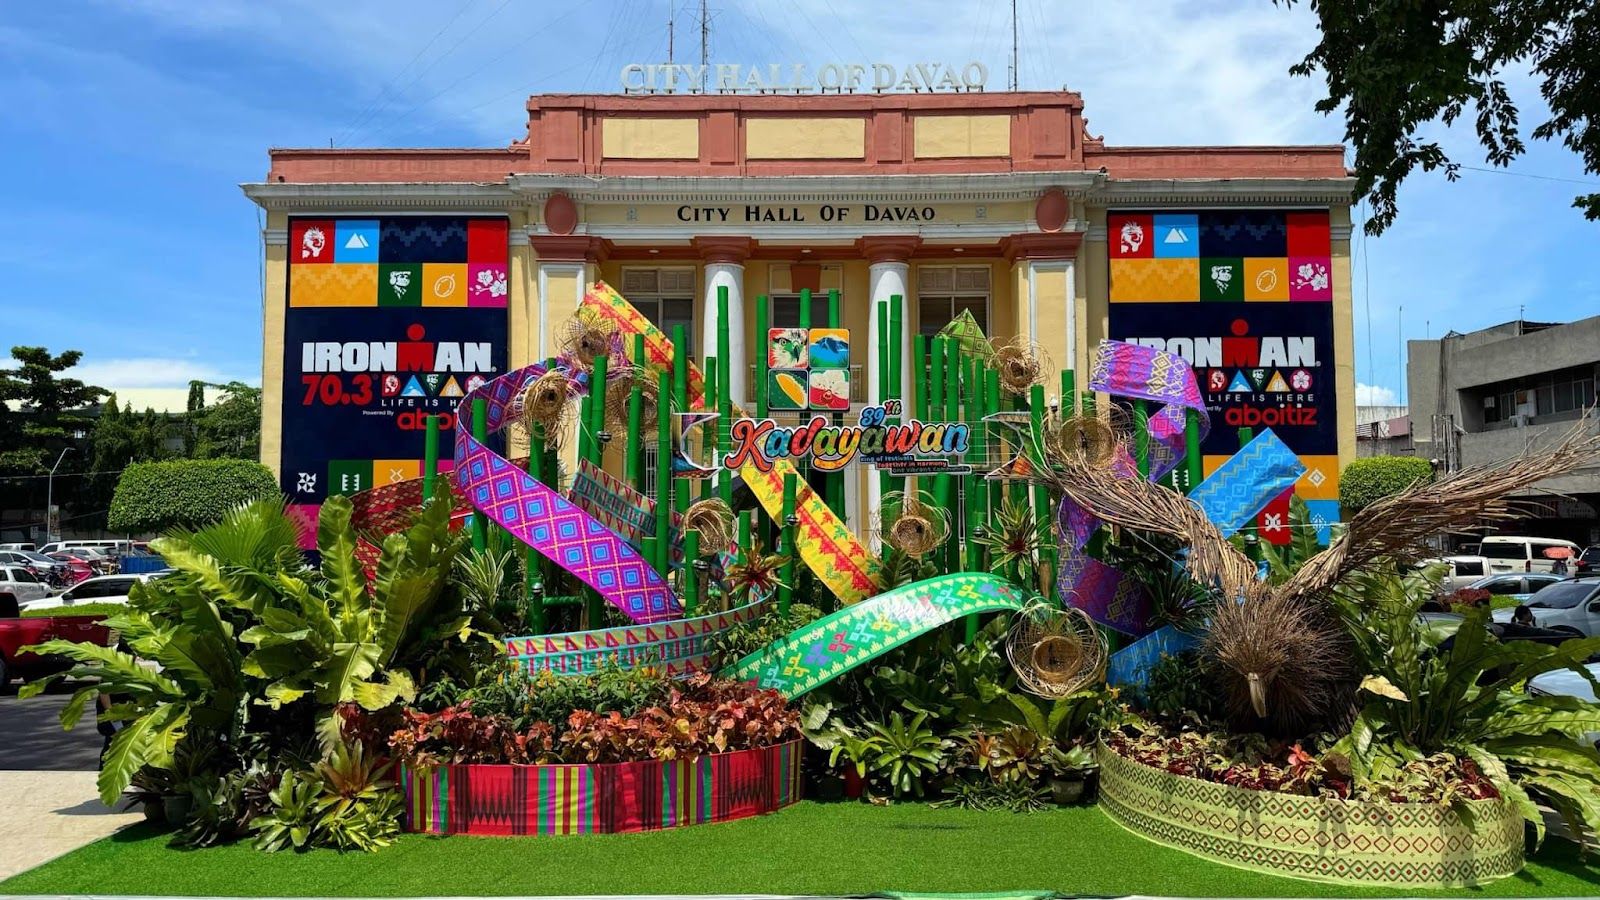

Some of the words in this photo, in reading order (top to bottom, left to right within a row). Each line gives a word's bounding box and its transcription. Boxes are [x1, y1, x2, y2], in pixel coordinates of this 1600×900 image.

[620, 63, 706, 90] CITY
[716, 63, 813, 90] HALL
[818, 63, 866, 90] OF
[872, 62, 989, 89] DAVAO
[302, 342, 492, 372] IRONMAN
[1125, 337, 1316, 367] ONMAN
[302, 374, 373, 406] 70.3
[381, 399, 414, 407] LIFE
[425, 399, 439, 407] IS
[1225, 404, 1317, 425] aboitiz
[725, 418, 968, 472] Kadayawan
